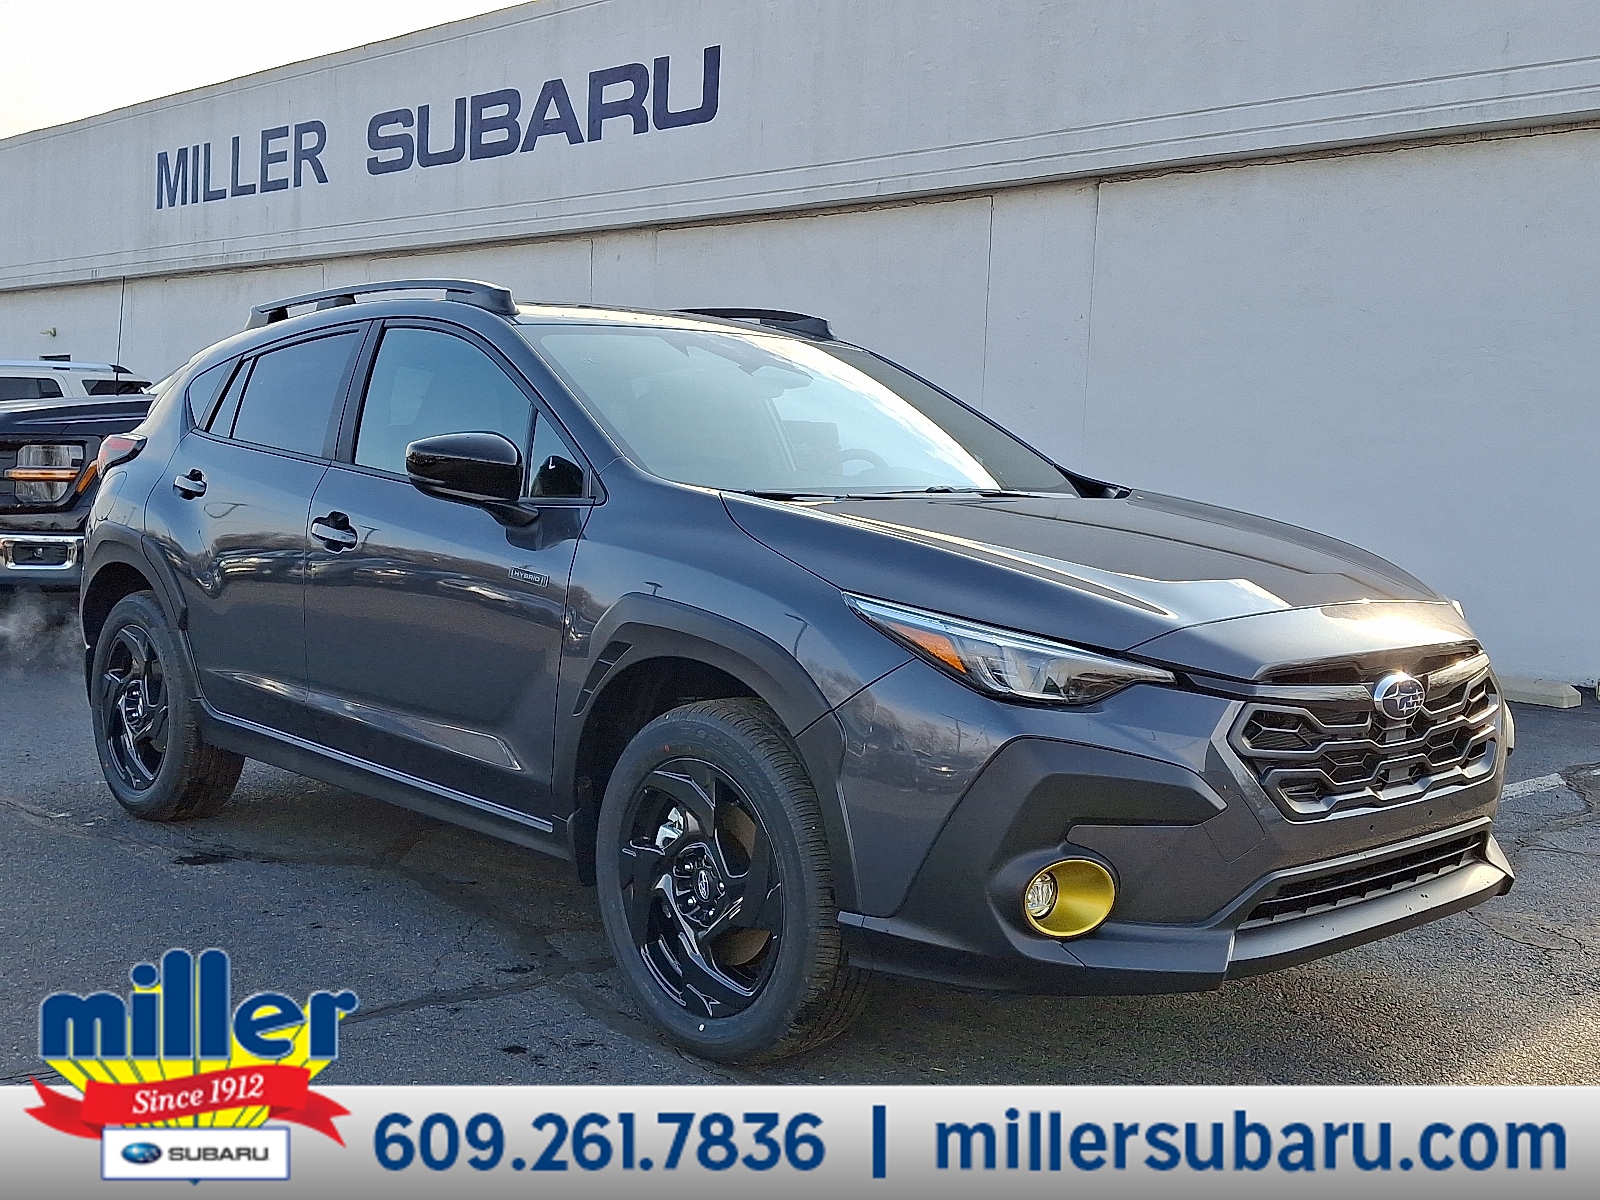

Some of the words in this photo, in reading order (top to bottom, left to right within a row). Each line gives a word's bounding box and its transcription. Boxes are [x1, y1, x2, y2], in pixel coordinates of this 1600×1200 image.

[156, 120, 328, 210] MILLER
[367, 45, 722, 176] SUBARU
[513, 570, 541, 582] HYBRID
